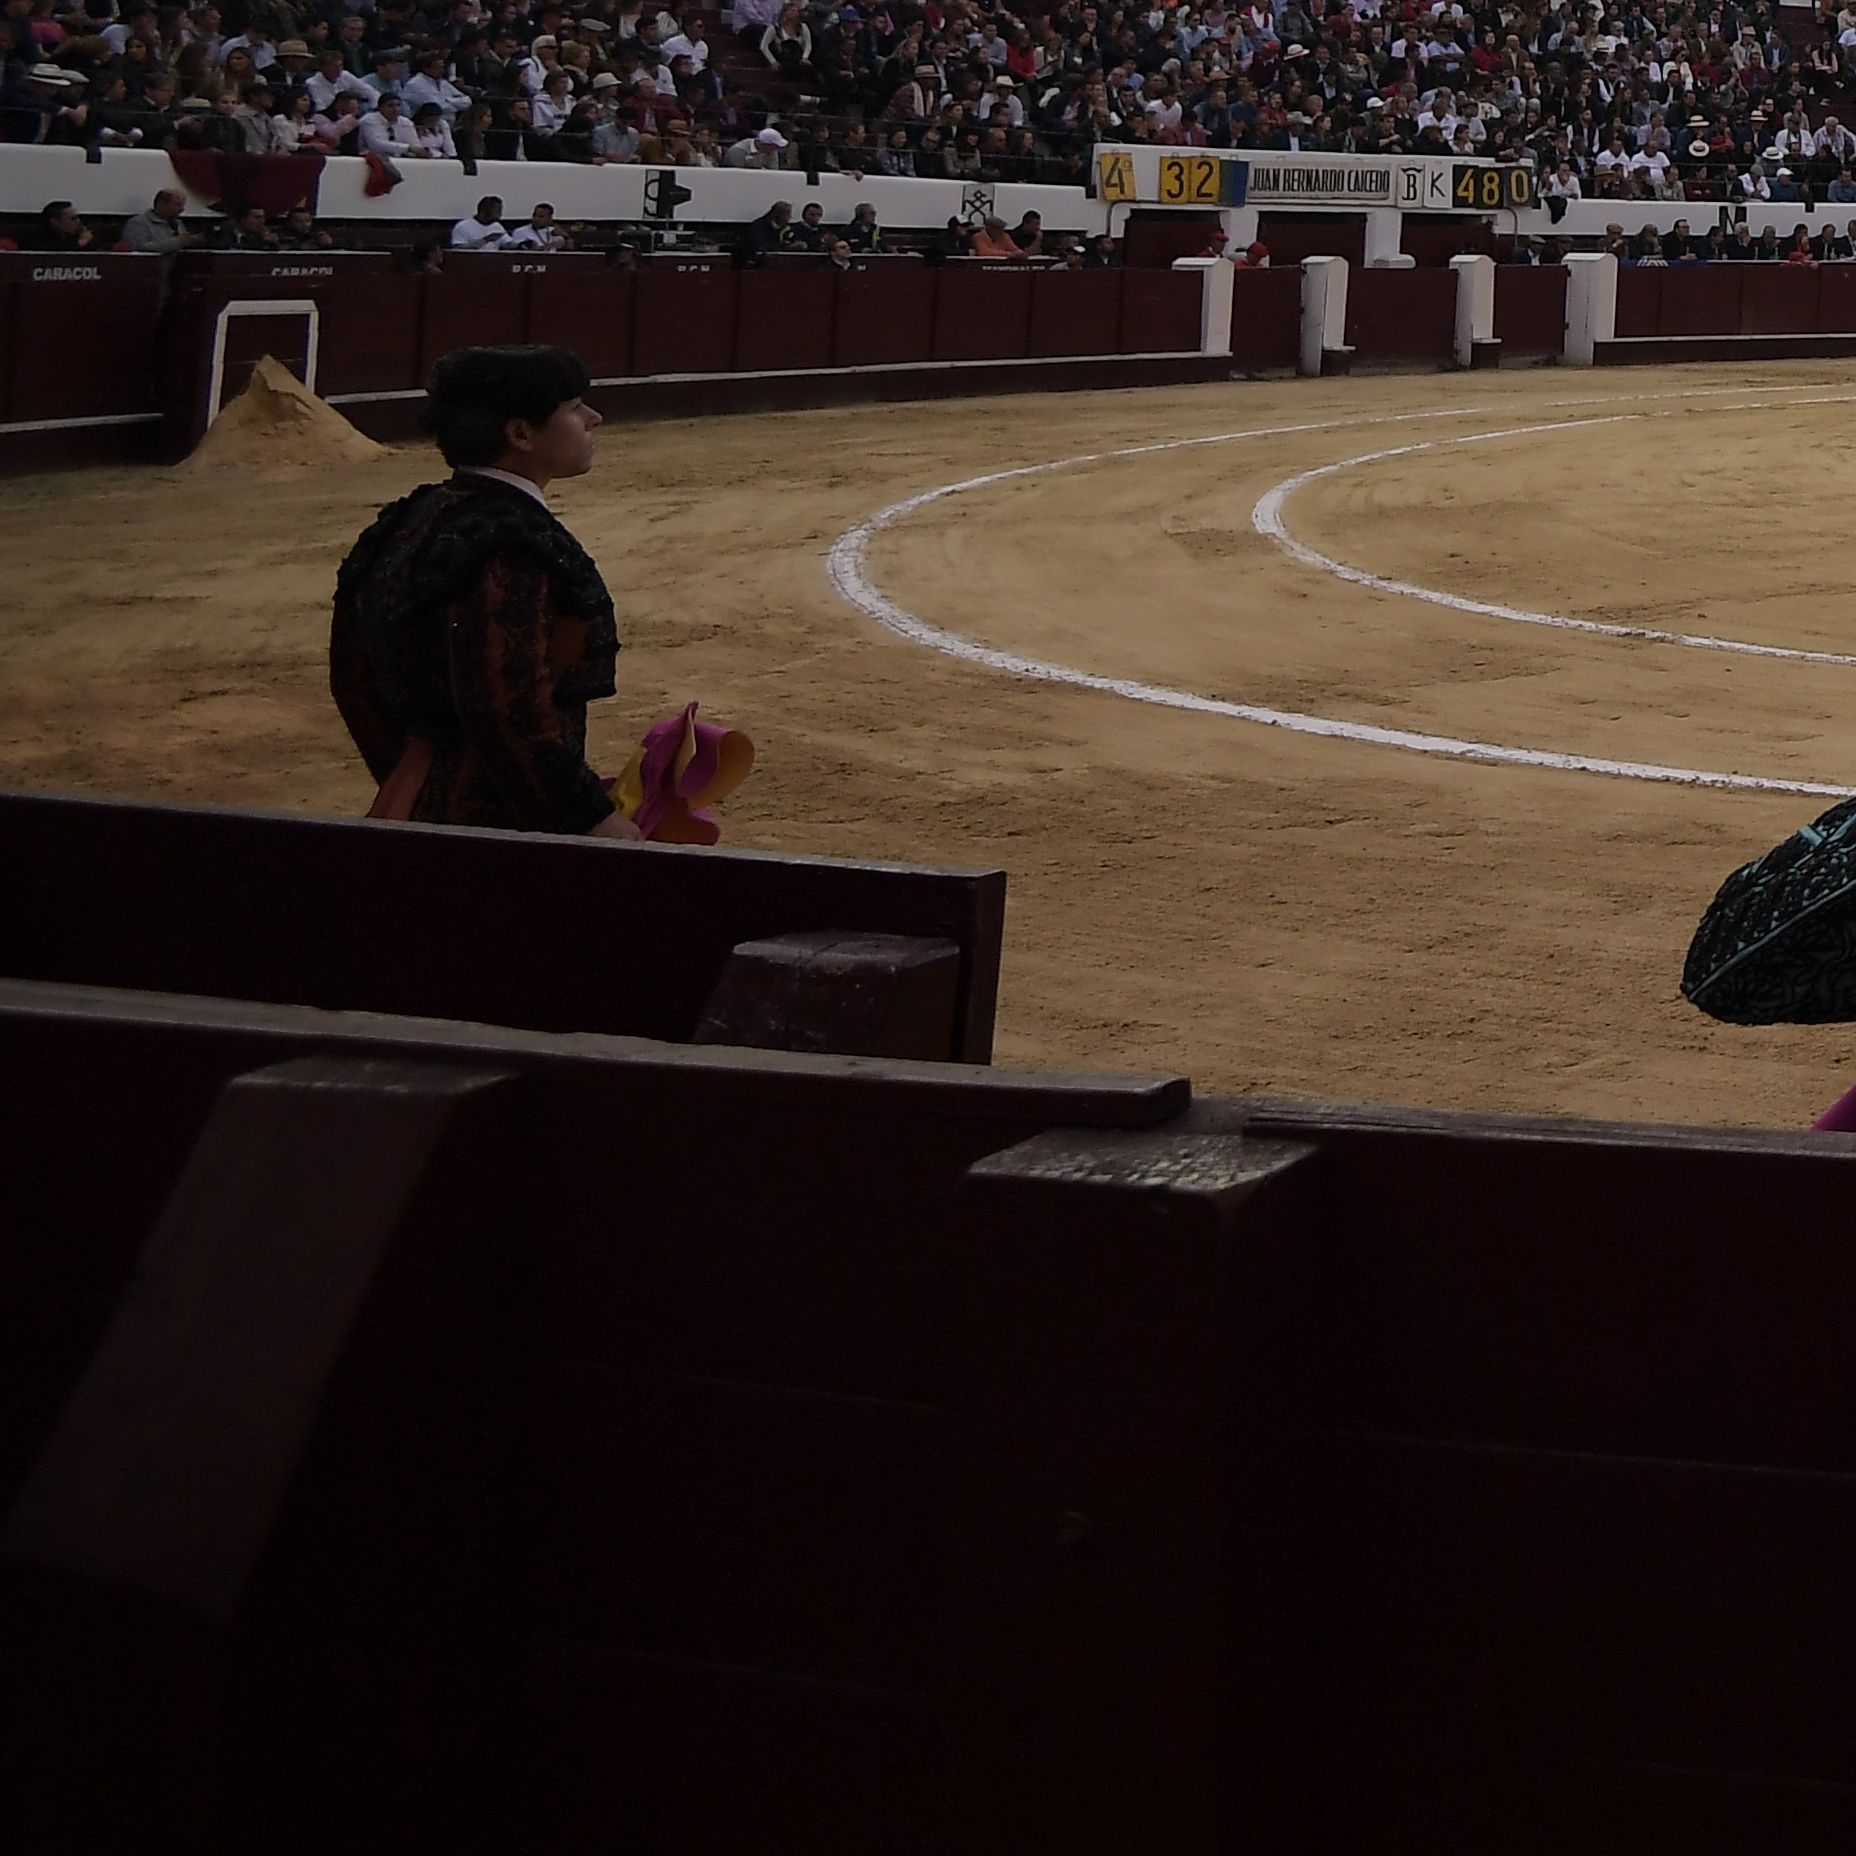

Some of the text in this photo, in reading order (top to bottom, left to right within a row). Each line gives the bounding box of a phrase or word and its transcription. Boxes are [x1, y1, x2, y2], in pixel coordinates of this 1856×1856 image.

[1166, 160, 1215, 199] 32
[1250, 167, 1390, 193] JUAN BERNARDO CAICEDO
[1456, 168, 1530, 205] 480
[33, 266, 102, 281] CARACOL
